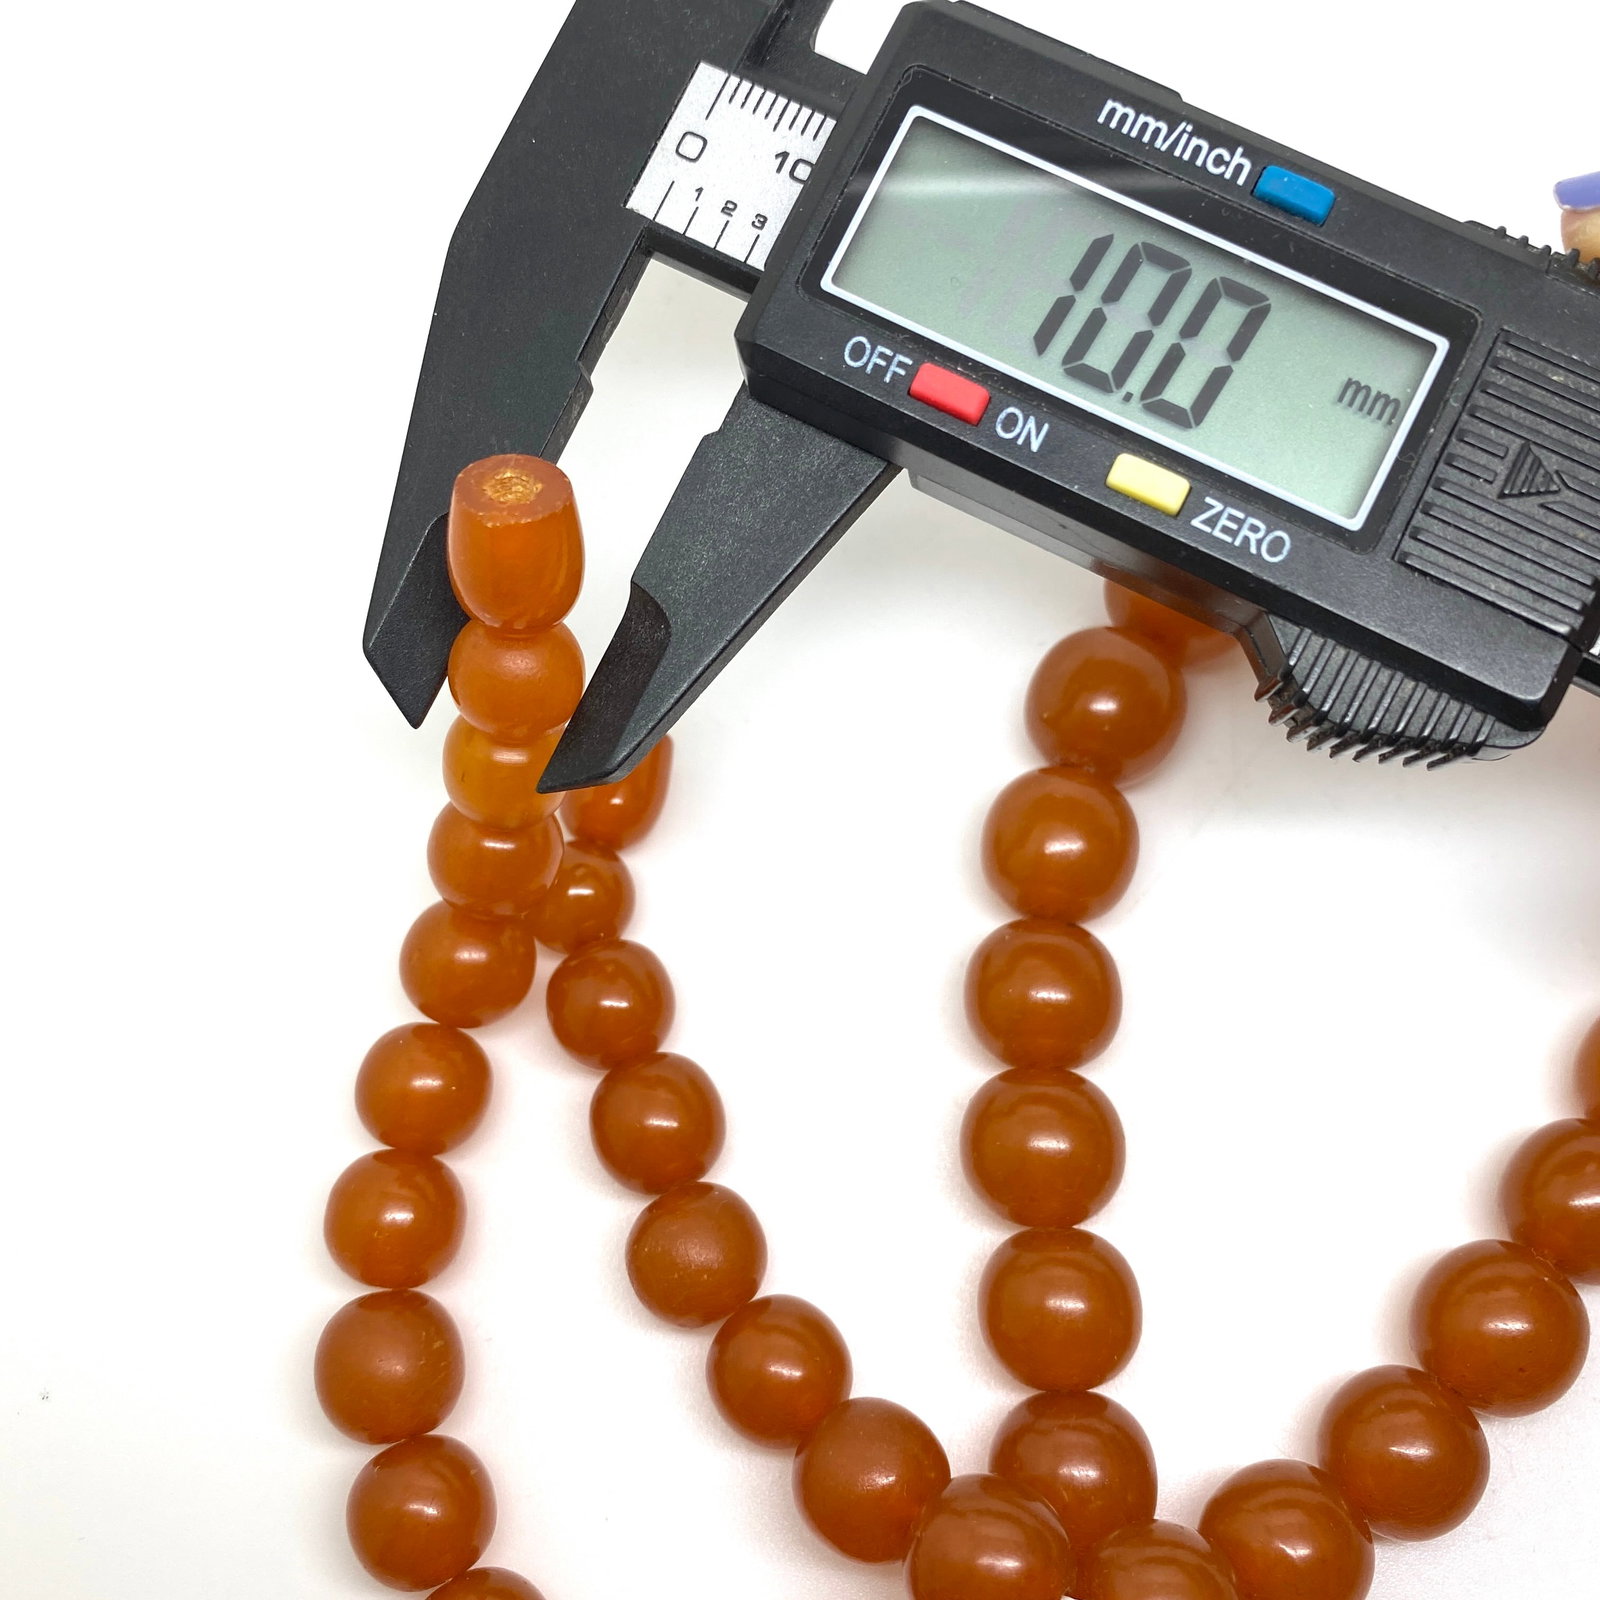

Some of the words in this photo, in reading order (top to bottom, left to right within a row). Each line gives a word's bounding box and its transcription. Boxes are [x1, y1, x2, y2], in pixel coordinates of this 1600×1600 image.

[675, 131, 708, 163] 0
[774, 150, 815, 185] 10
[1097, 98, 1252, 186] mm/inch
[843, 336, 914, 384] OFF
[1033, 233, 1272, 429] 10.0
[1337, 376, 1402, 427] mm
[994, 407, 1050, 453] ON
[1190, 497, 1291, 564] ZERO
